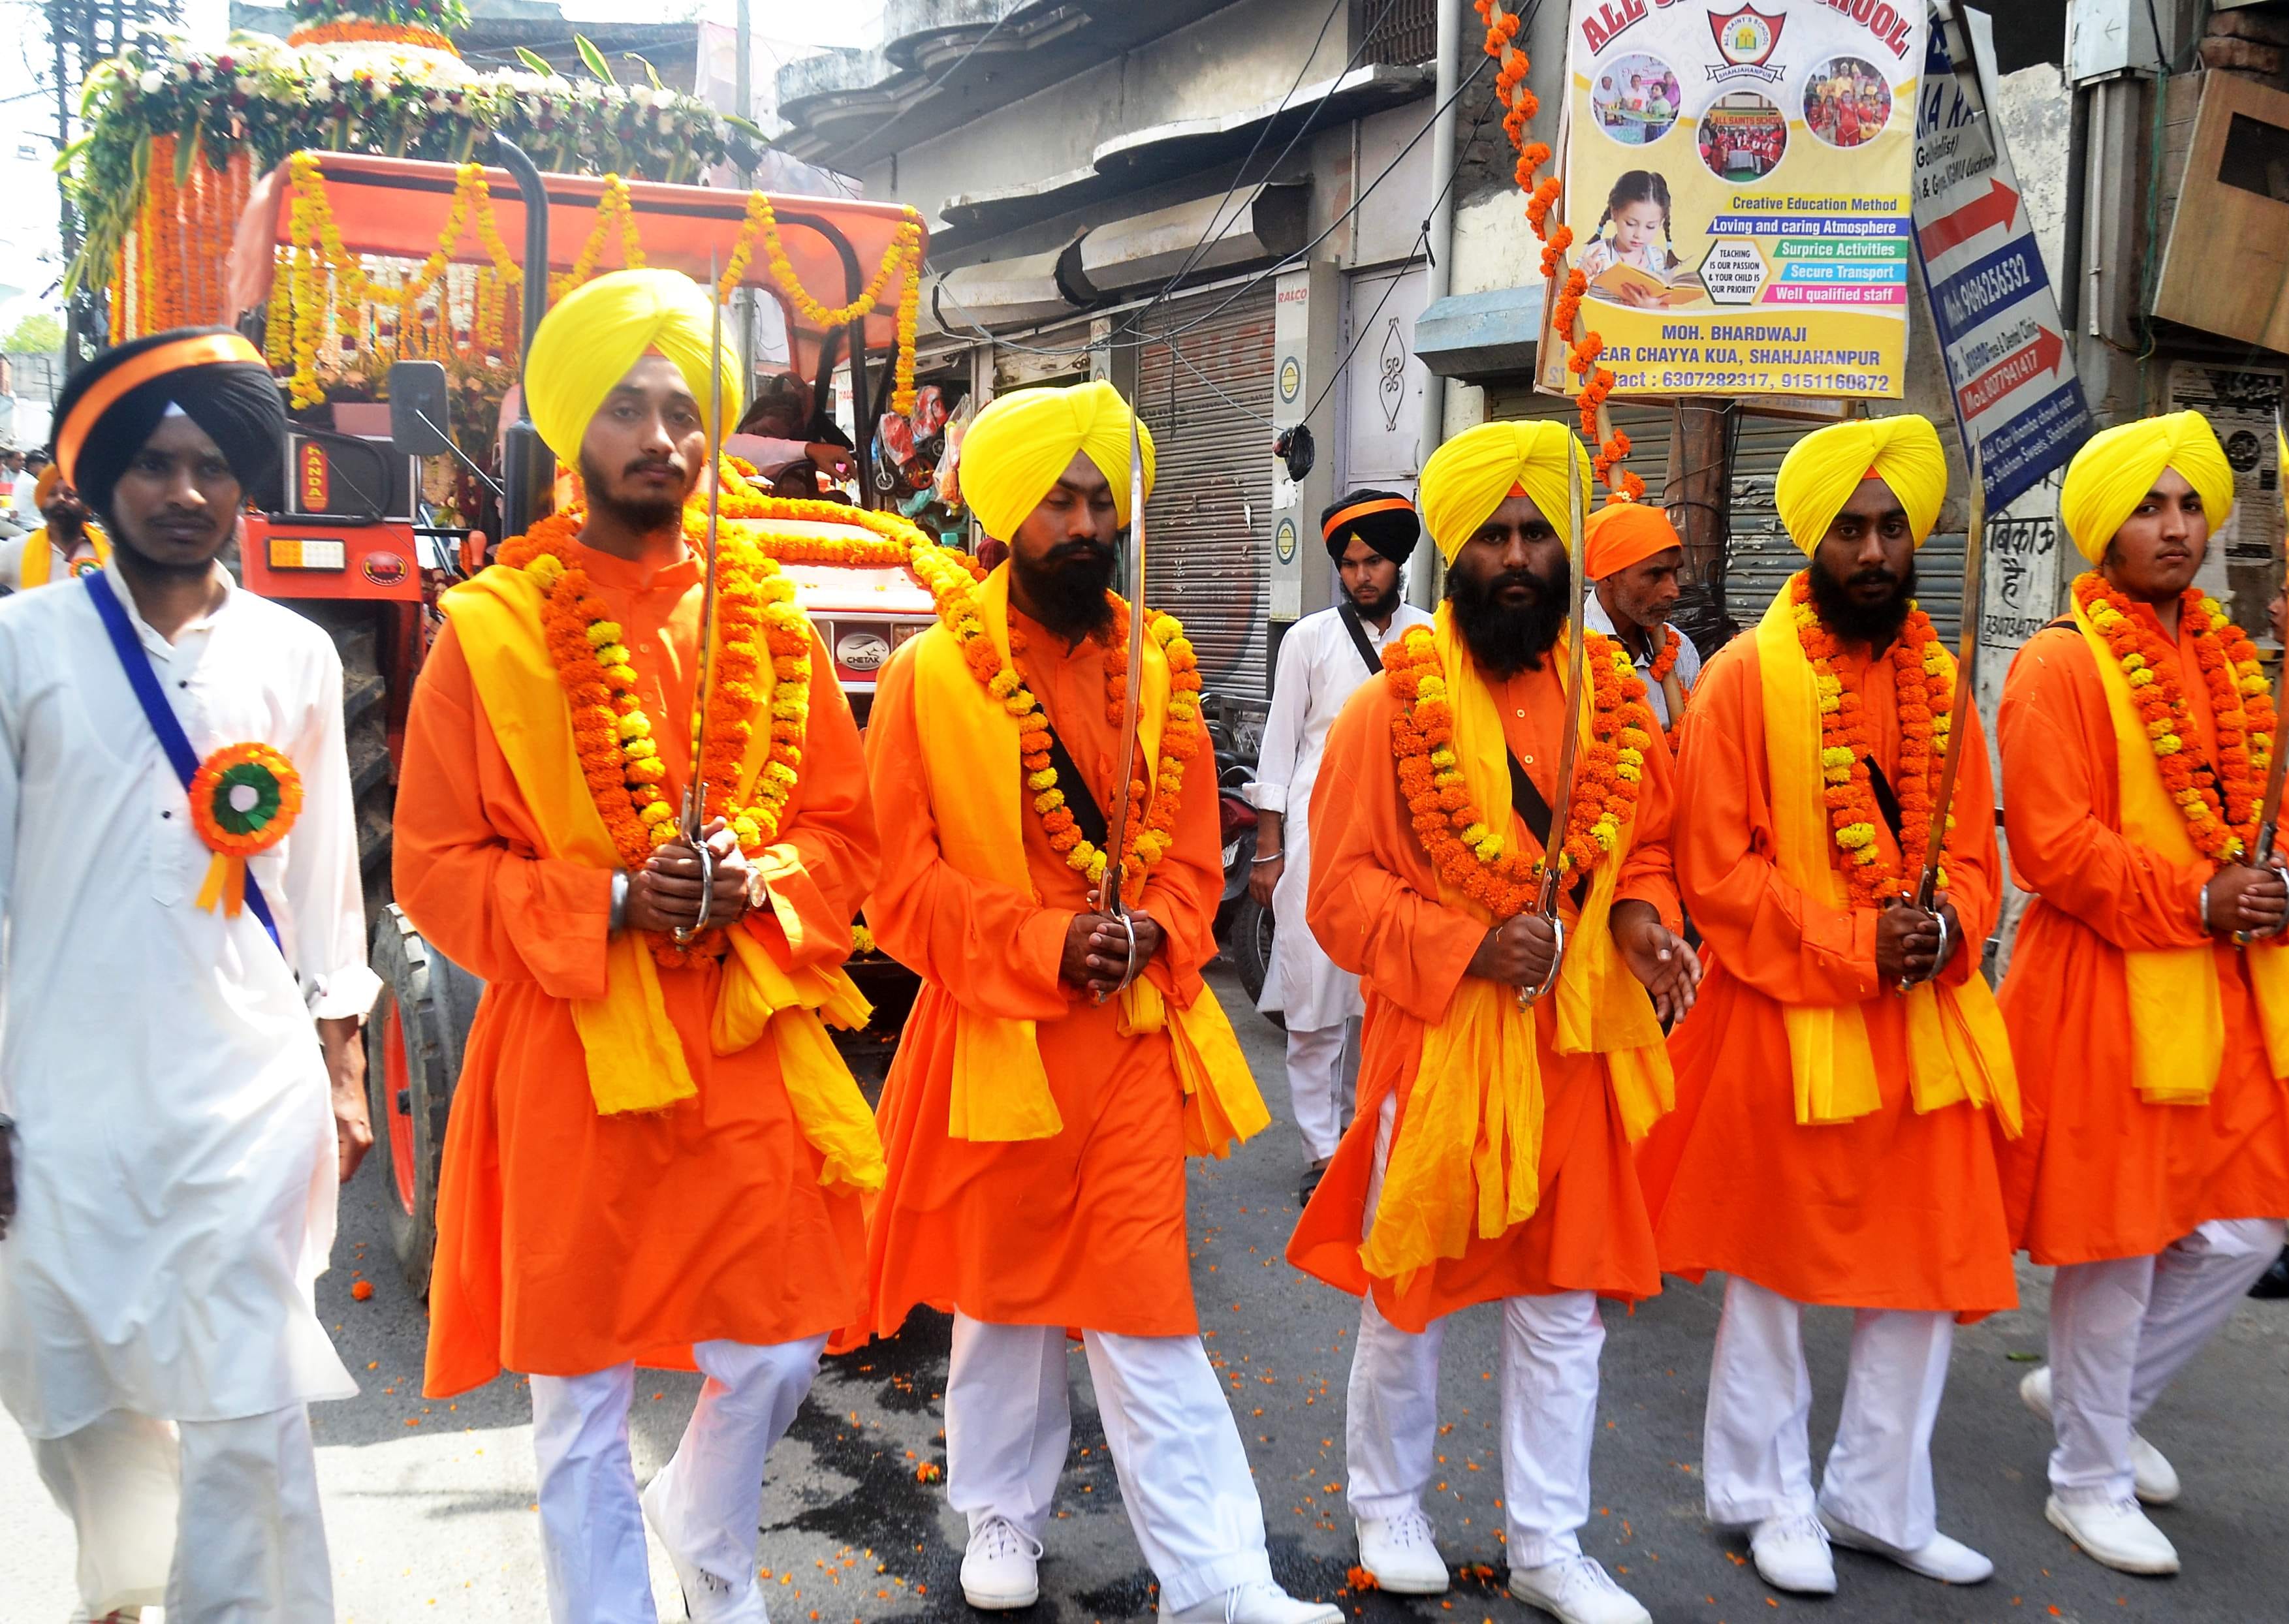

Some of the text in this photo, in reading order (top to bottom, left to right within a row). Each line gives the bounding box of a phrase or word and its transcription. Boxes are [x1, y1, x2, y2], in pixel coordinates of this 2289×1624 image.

[1718, 67, 1772, 79] SHAHJAHANPUR
[1733, 196, 1897, 211] Creative Education Method
[1713, 219, 1897, 236] Loving and caring Atmosphere
[1720, 249, 1750, 258] TEACHING
[1782, 242, 1895, 257] Surprice Activities
[1791, 265, 1894, 281] Secure Transport
[1277, 288, 1307, 304] RALCO
[1776, 287, 1893, 302] Well qualified staff
[1662, 325, 1807, 342] MOH. BHARDWAJI
[1636, 347, 1699, 363] CHAYYA
[1705, 349, 1744, 366] KUA,
[1749, 349, 1880, 366] SHAHJAHANPUR
[1579, 371, 1646, 387] tact
[1781, 373, 1889, 392] 9151160872
